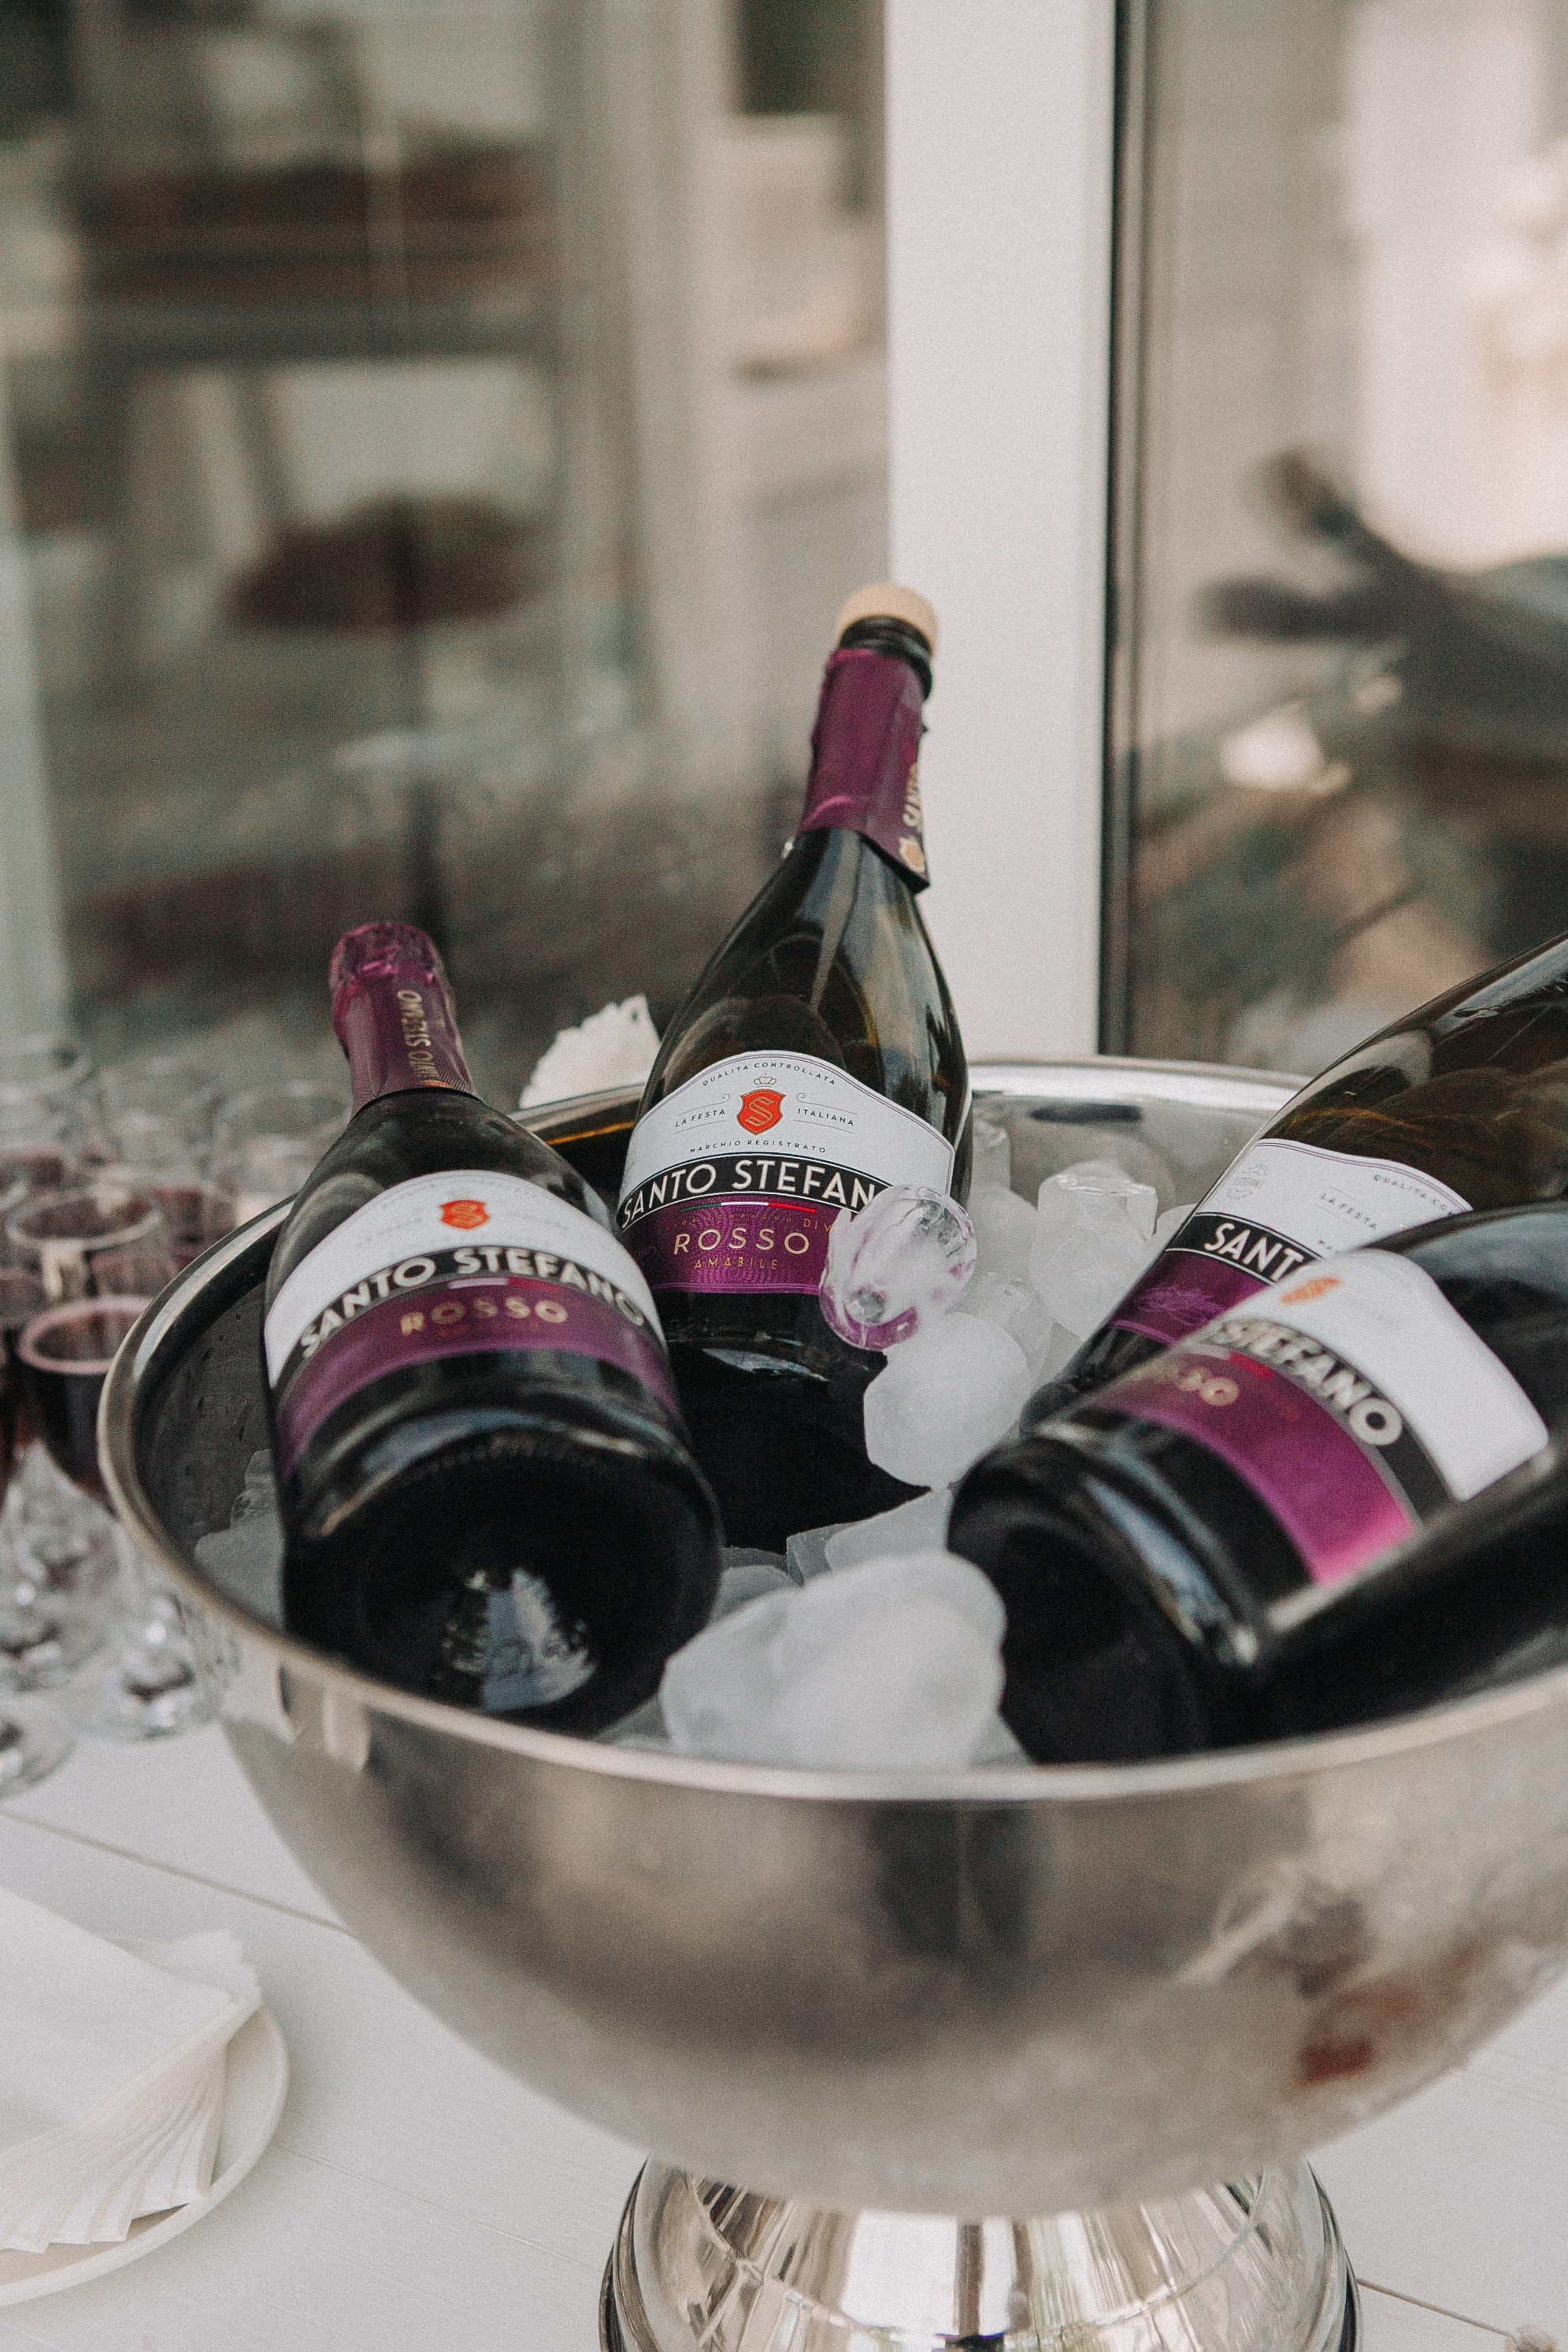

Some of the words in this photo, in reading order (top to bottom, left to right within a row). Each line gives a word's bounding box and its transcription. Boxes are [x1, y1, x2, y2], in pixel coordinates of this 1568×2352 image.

[702, 1064, 749, 1086] QUALITA
[754, 1062, 836, 1085] CONTROLLATA
[674, 1118, 688, 1128] LA
[691, 1107, 726, 1122] FESTA
[796, 1107, 854, 1126] ITALIANA
[688, 1140, 742, 1154] MARCHIO
[747, 1139, 827, 1154] REGISTRATO
[621, 1163, 717, 1228] SANTO
[730, 1159, 877, 1208] STEFAN
[673, 1227, 810, 1255] ROSSO
[1203, 1222, 1305, 1282] SANT
[694, 1256, 778, 1271] AMABILE
[301, 1256, 436, 1359] SANTO
[454, 1247, 644, 1326] STEFANO
[399, 1295, 569, 1337] ROSSO
